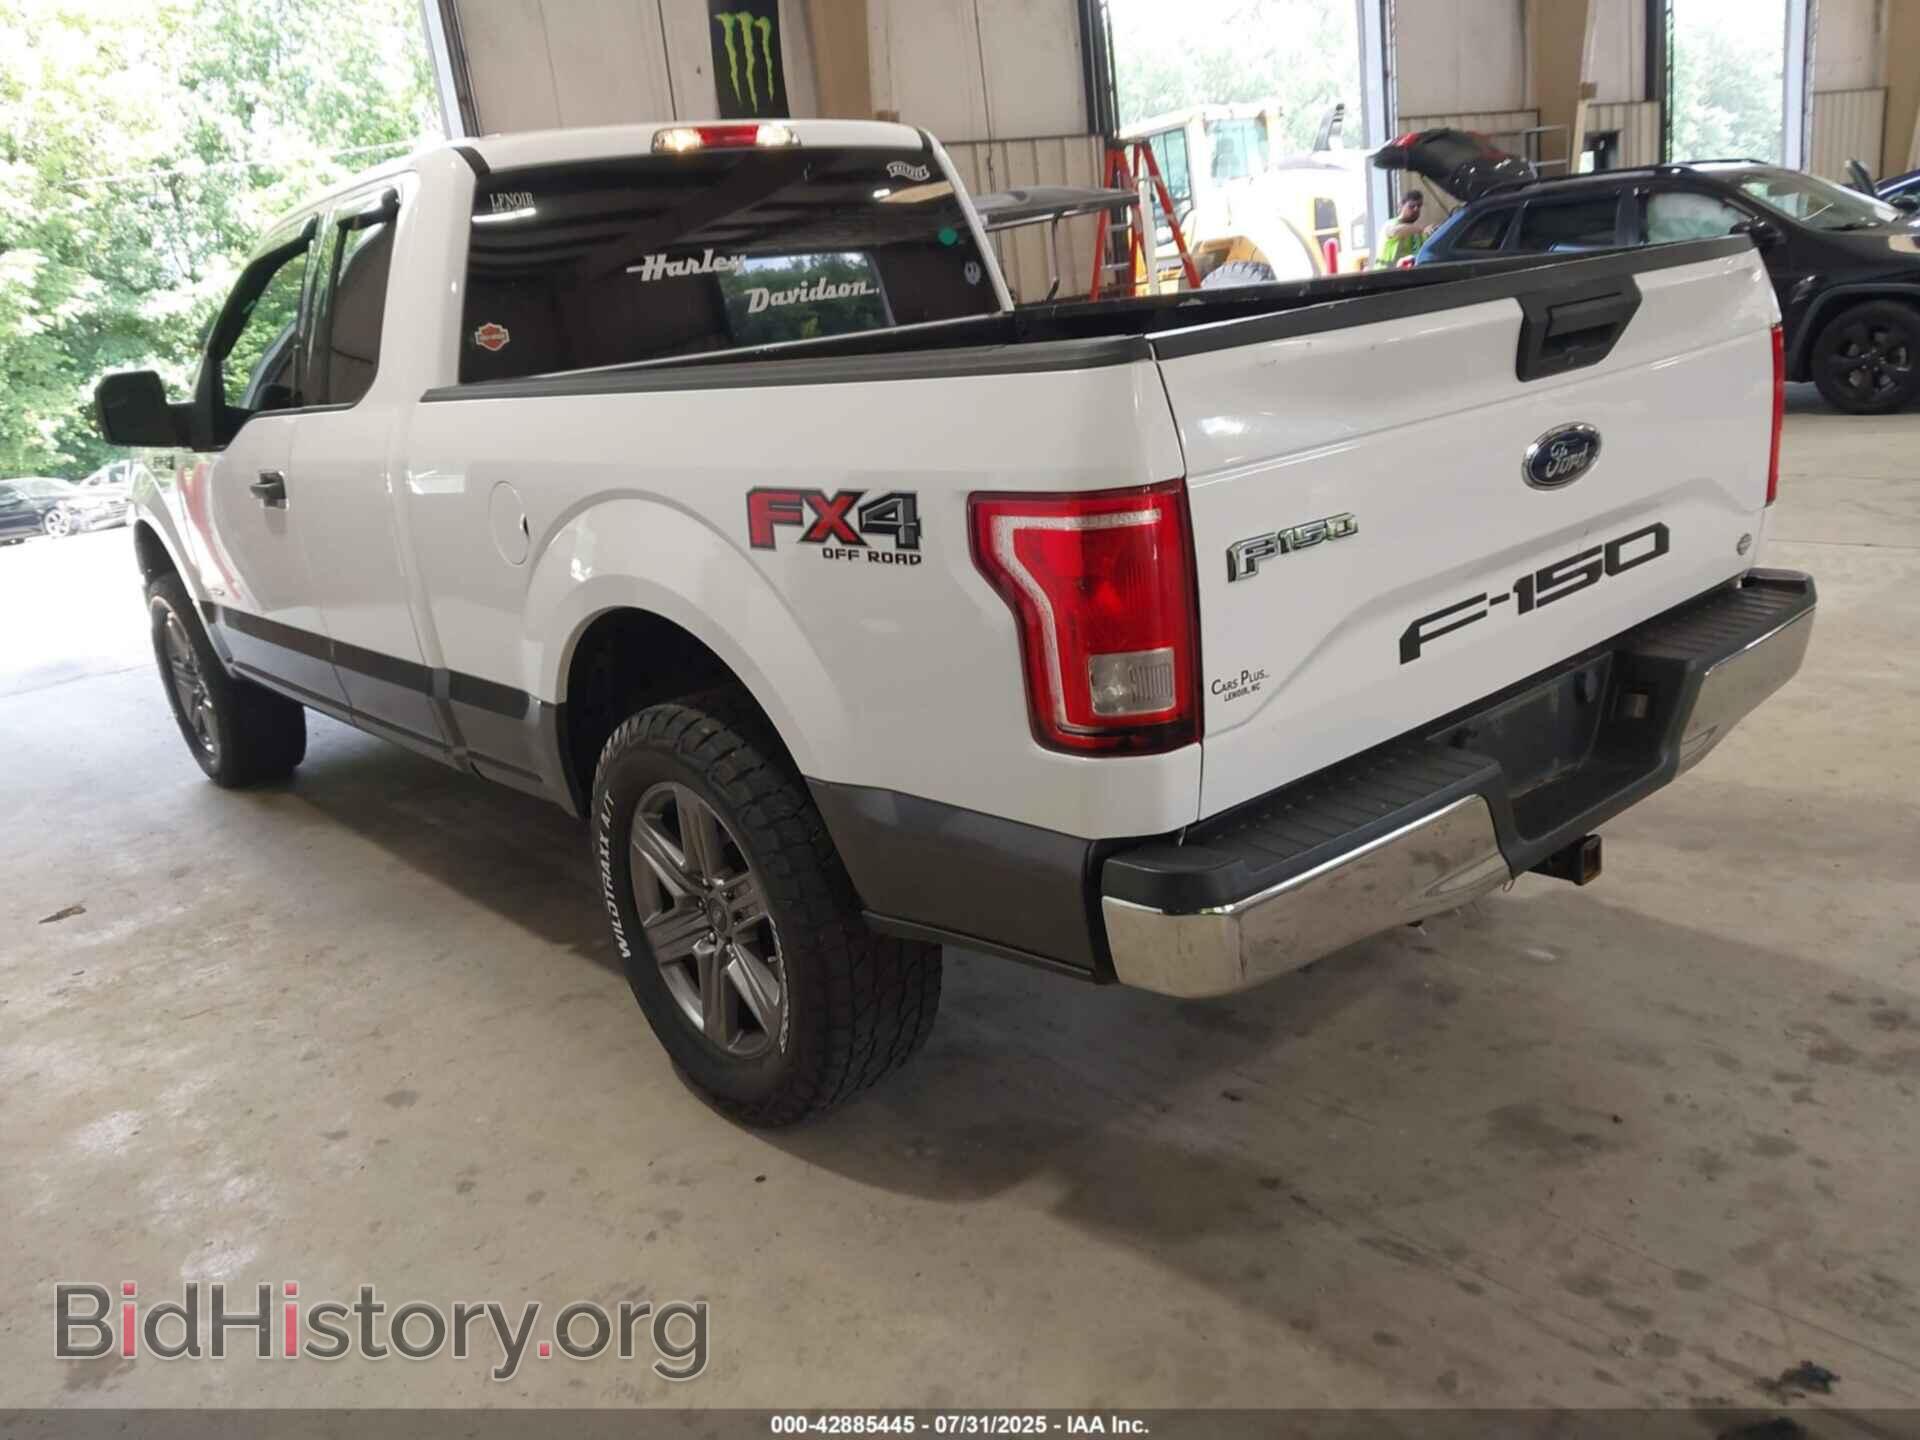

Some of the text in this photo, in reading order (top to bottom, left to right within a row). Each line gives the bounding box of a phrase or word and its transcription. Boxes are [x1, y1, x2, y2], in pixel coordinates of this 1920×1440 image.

[627, 249, 747, 281] Harley
[744, 277, 880, 313] Davidson
[1545, 440, 1590, 479] Ford
[746, 486, 922, 550] FX4
[822, 547, 922, 566] OFF ROAD
[1399, 521, 1669, 665] F-150
